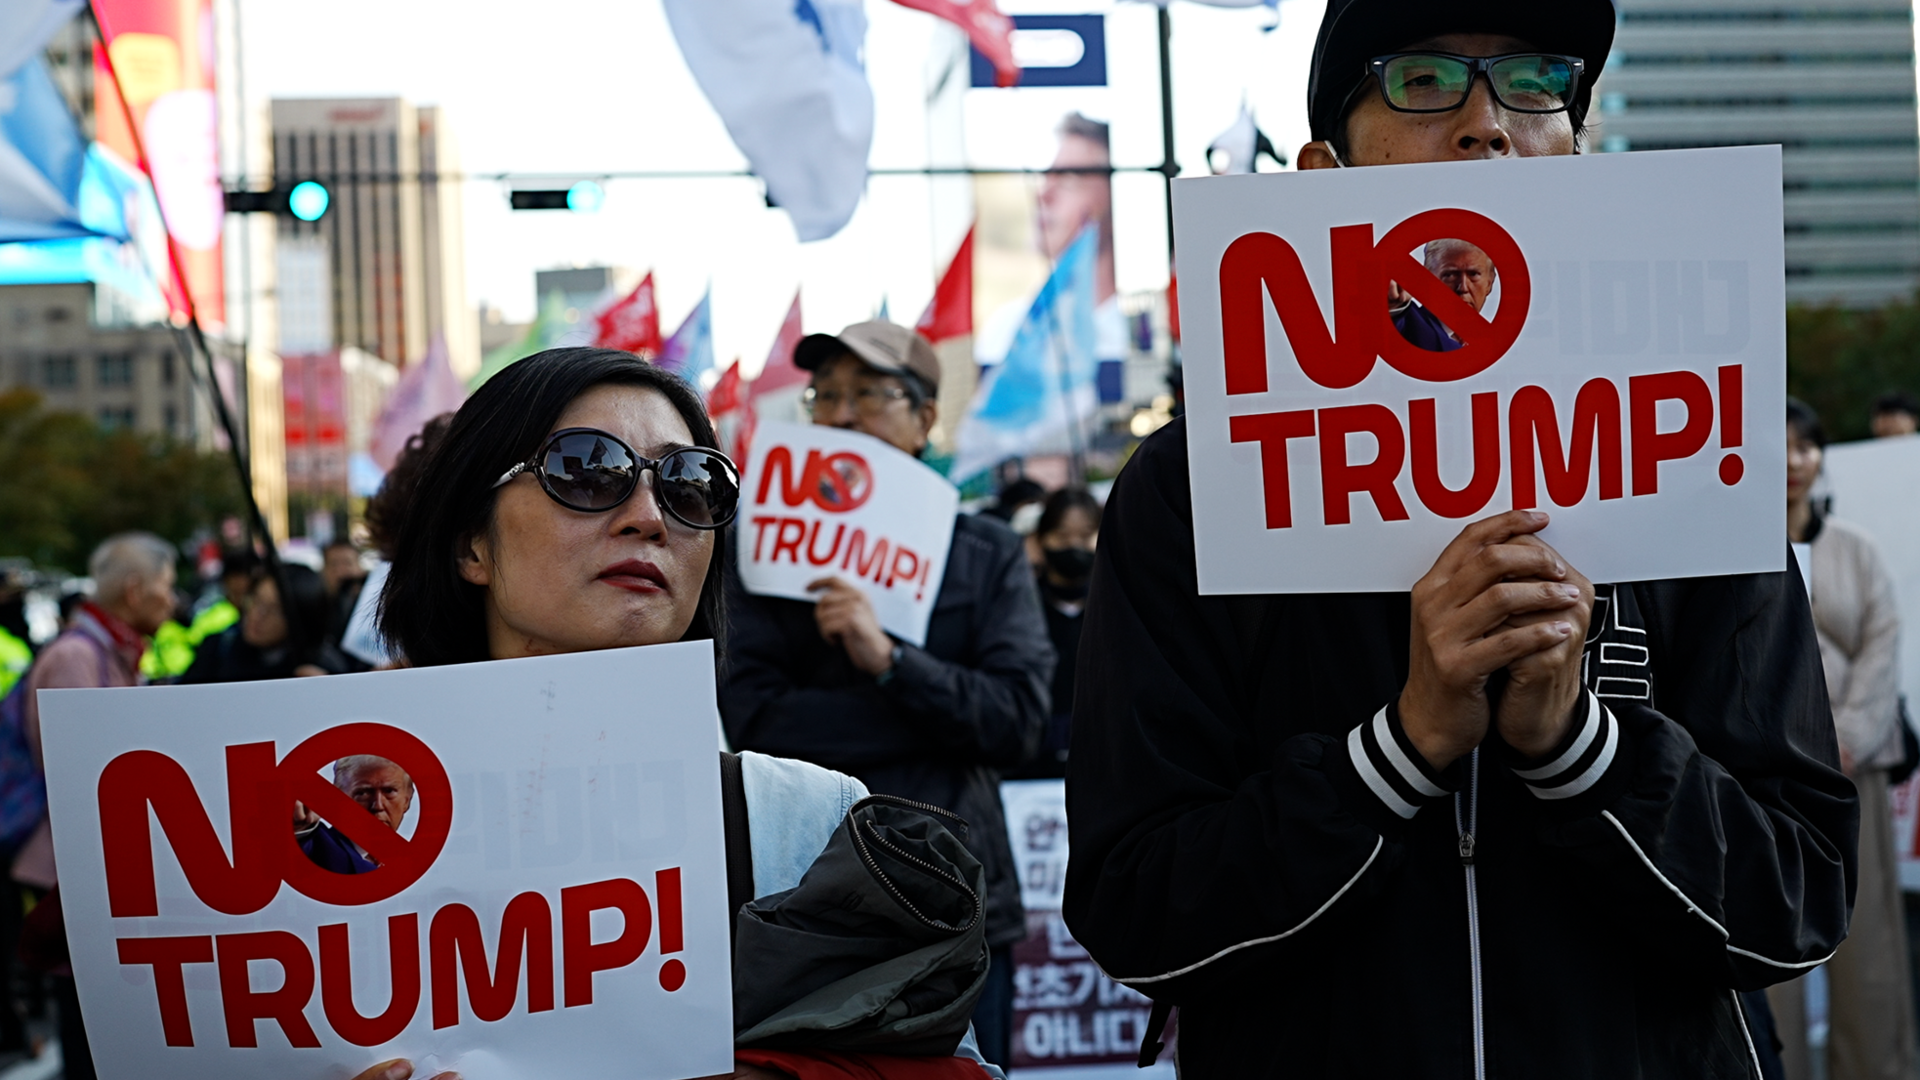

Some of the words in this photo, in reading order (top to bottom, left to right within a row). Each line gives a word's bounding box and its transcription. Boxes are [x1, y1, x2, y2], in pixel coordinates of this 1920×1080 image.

[1220, 207, 1532, 396] NO
[754, 443, 874, 513] NO
[1230, 364, 1744, 530] TRUMP!
[752, 516, 930, 602] TRUMP!
[97, 722, 453, 917] NO
[116, 867, 688, 1049] TRUMP!
